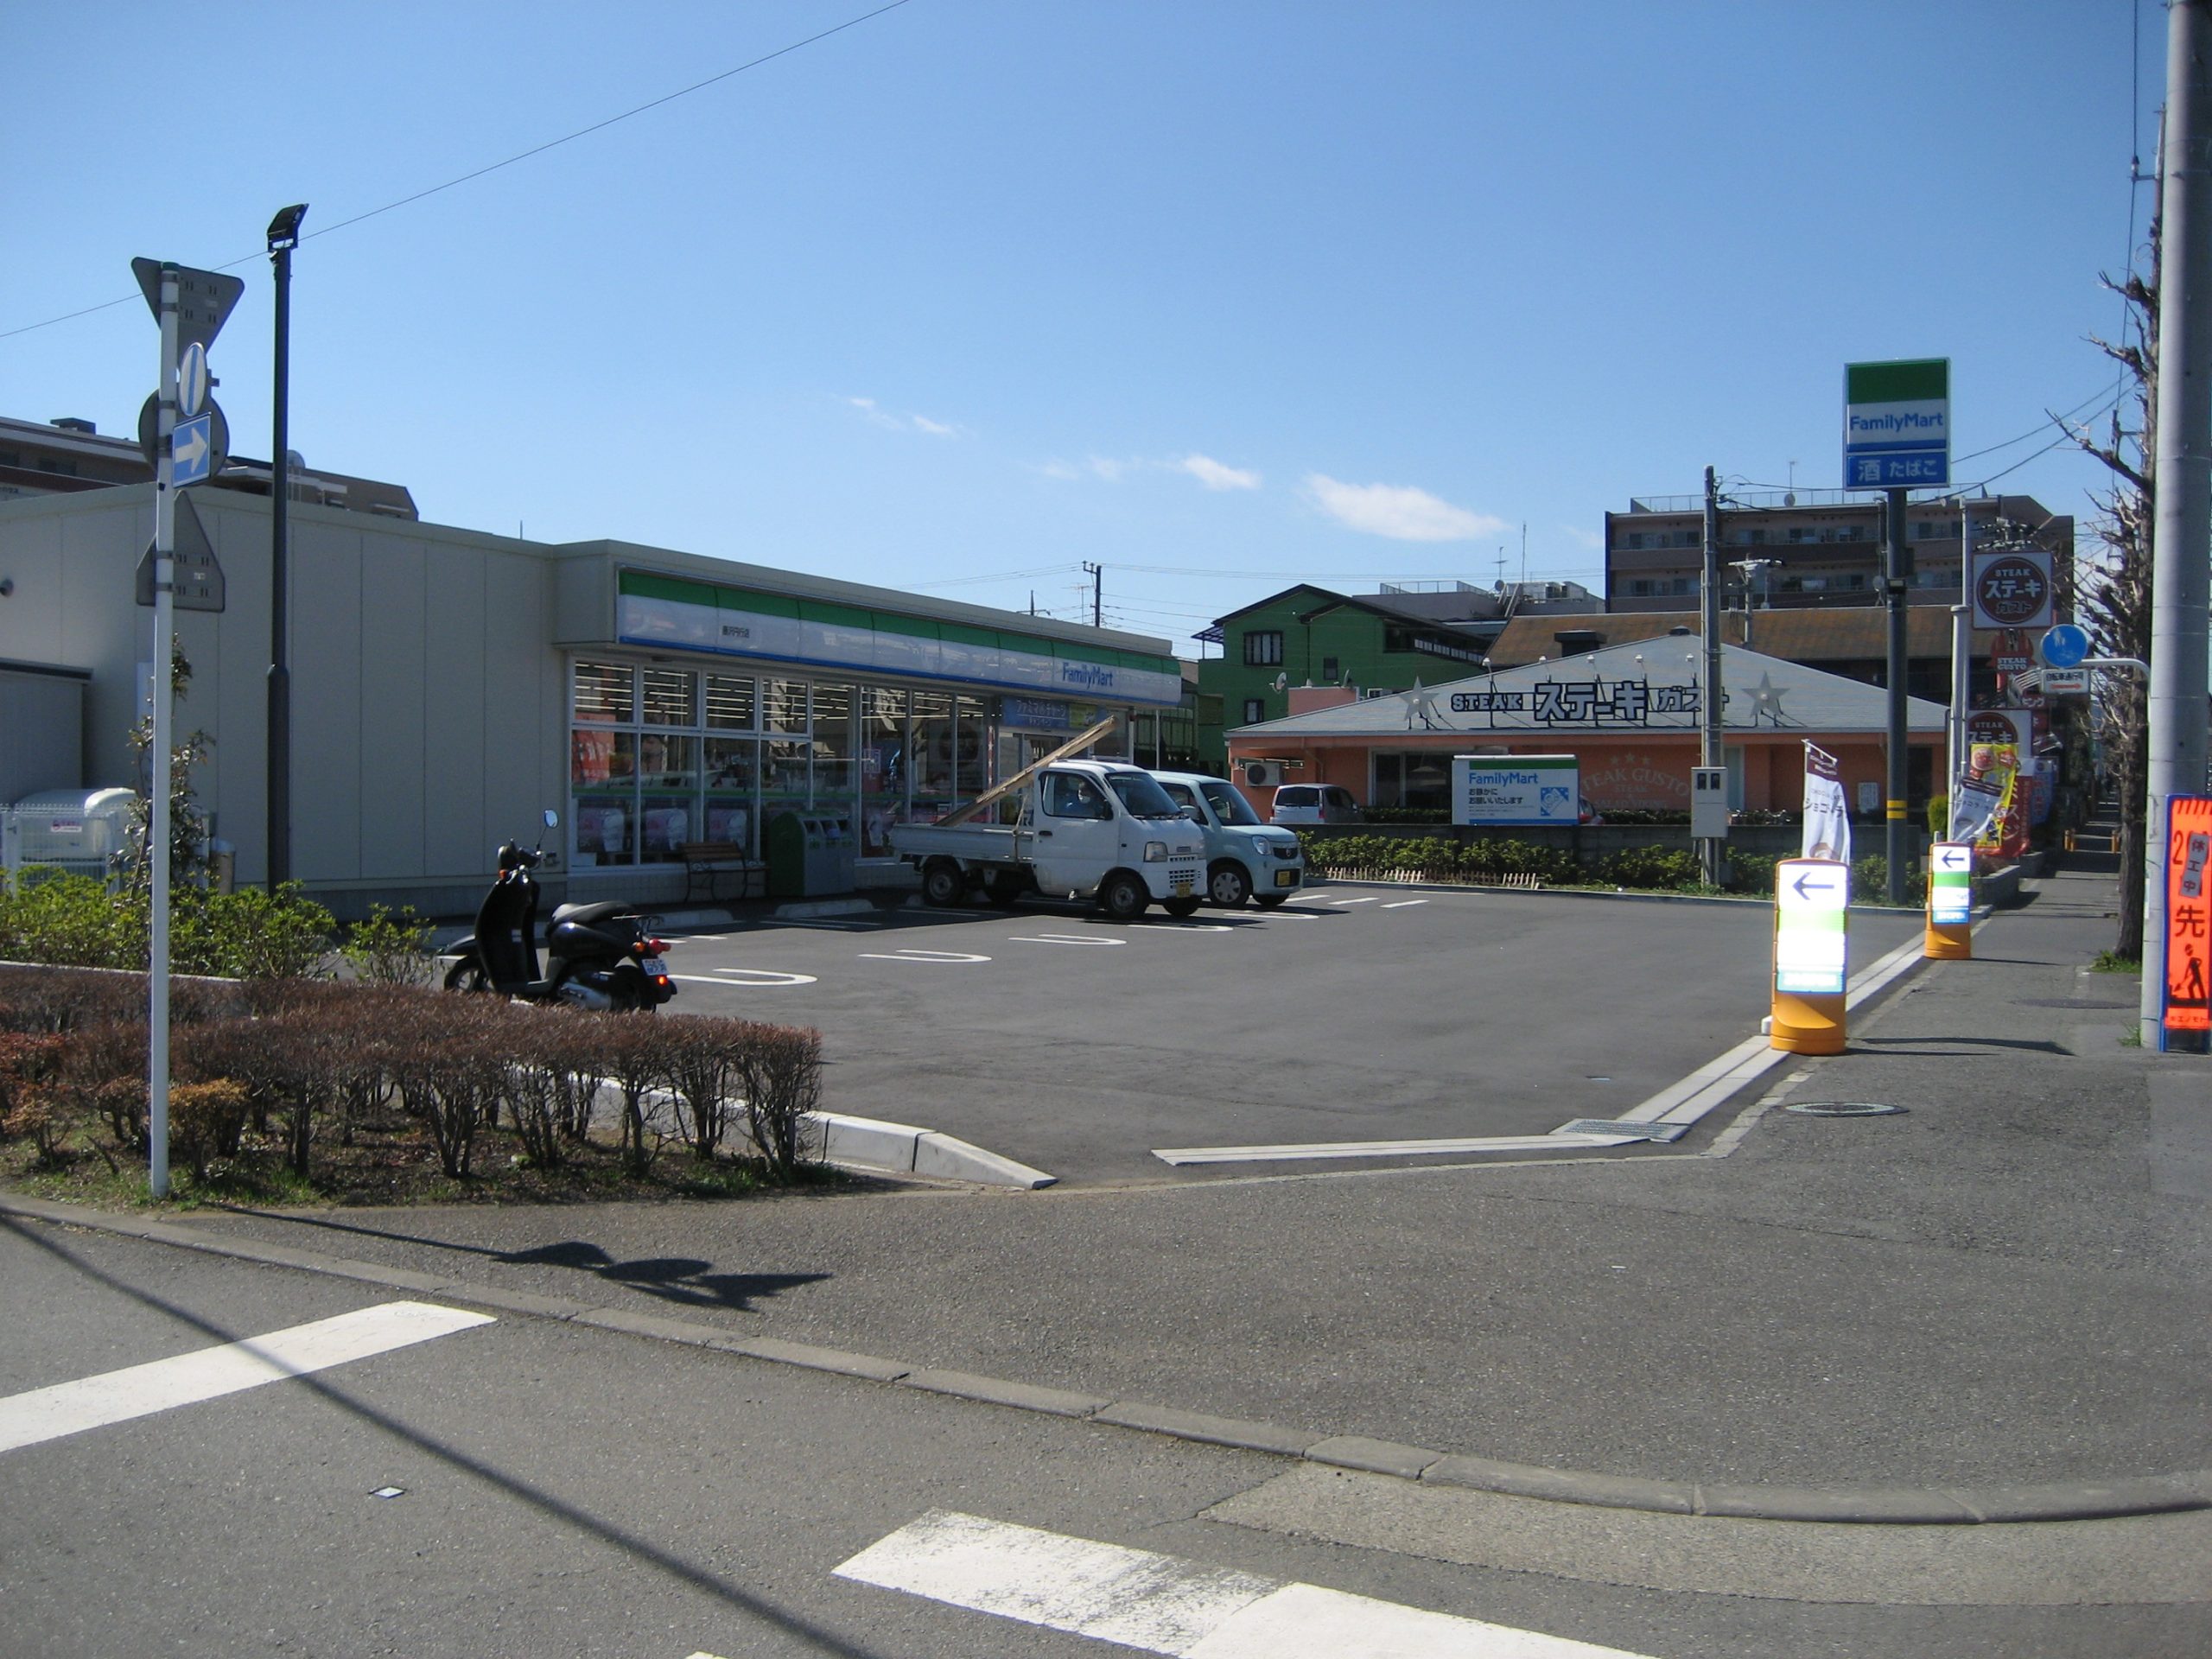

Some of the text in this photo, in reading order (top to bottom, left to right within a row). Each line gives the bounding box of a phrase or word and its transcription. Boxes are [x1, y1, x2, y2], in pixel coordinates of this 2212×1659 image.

[1849, 412, 1943, 432] FamilyMart
[1859, 460, 1937, 482] 酒 たばこ
[1985, 579, 2042, 599] ステーキ
[1996, 601, 2032, 614] ガスト
[1062, 662, 1113, 689] FamilyMart
[1452, 694, 1522, 711] STEAK
[1535, 683, 1646, 721] ステーキ
[1469, 772, 1538, 787] FamilyMart
[1581, 767, 1690, 797] TEAK GUSTO
[2175, 905, 2205, 938] 先
